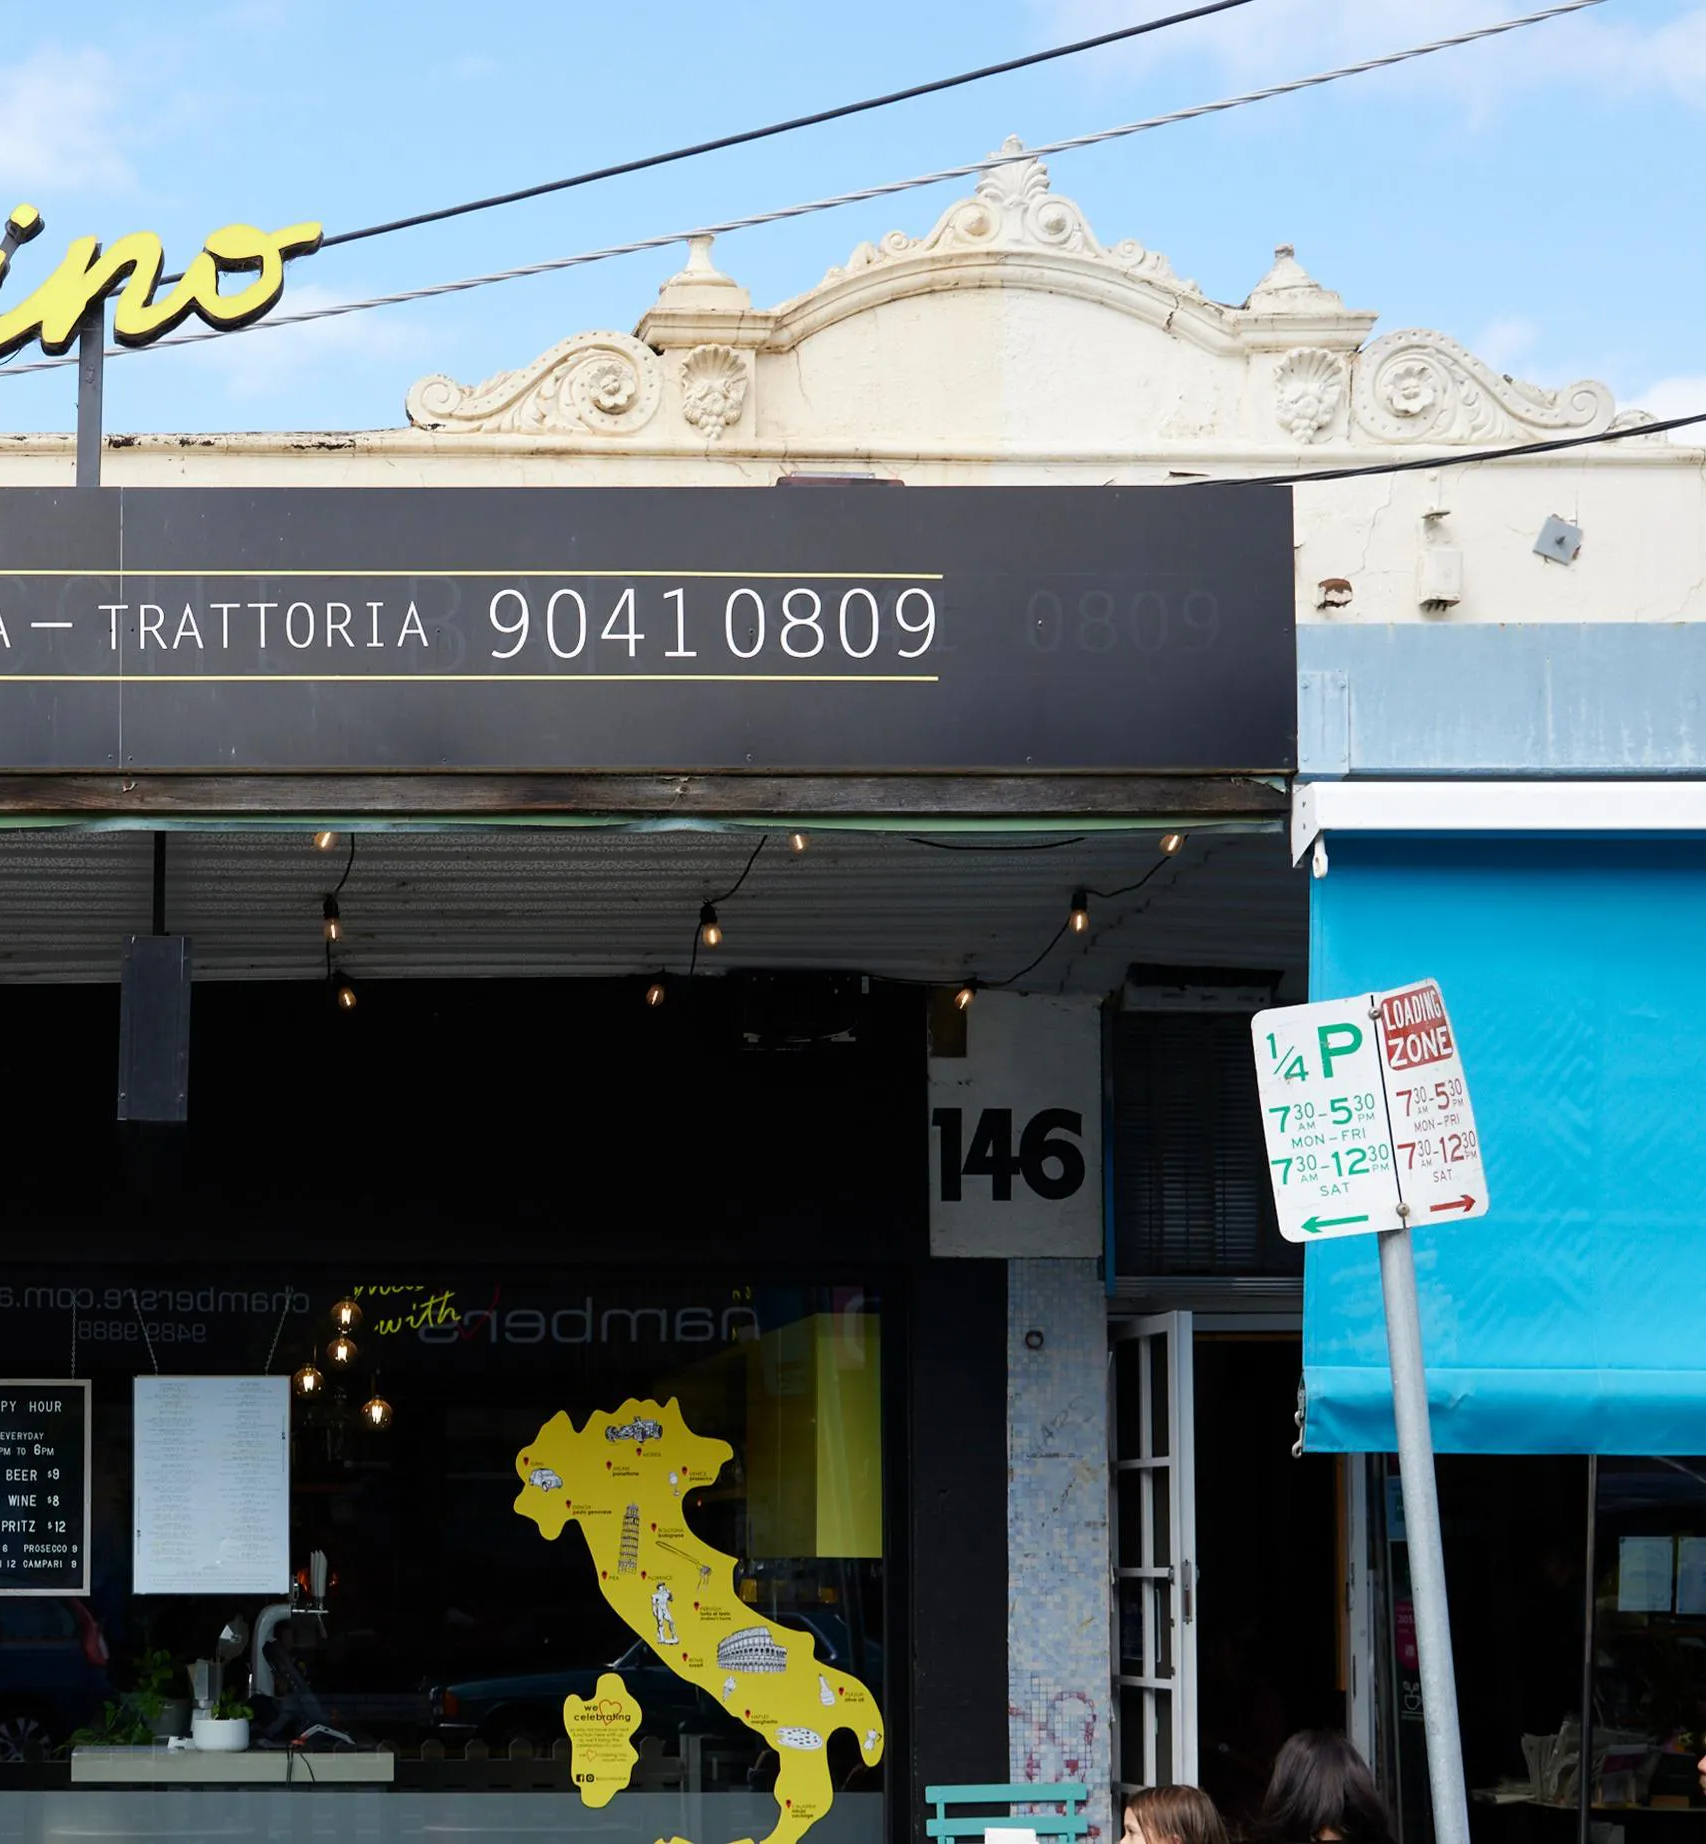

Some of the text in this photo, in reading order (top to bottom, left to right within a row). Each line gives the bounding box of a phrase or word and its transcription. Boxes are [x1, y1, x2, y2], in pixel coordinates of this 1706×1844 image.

[98, 600, 430, 651] TRATTORIA
[1383, 991, 1444, 1032] LOADING
[1317, 1022, 1363, 1079] P
[1388, 1027, 1454, 1066] ZONE
[931, 1108, 1085, 1202] 146
[1433, 1169, 1453, 1183] SAT
[1320, 1182, 1351, 1197] SAT
[374, 1290, 462, 1335] with
[29, 1400, 62, 1413] HOUR
[0, 1431, 45, 1441] EVERYDAY
[17, 1447, 26, 1456] TO
[5, 1469, 38, 1481] BEER
[8, 1495, 37, 1507] WINE
[23, 1544, 68, 1553] PROSECCO
[6, 1559, 17, 1569] 12
[22, 1559, 63, 1569] CAMPARI
[584, 1704, 598, 1712] we
[573, 1713, 631, 1722] celebrating
